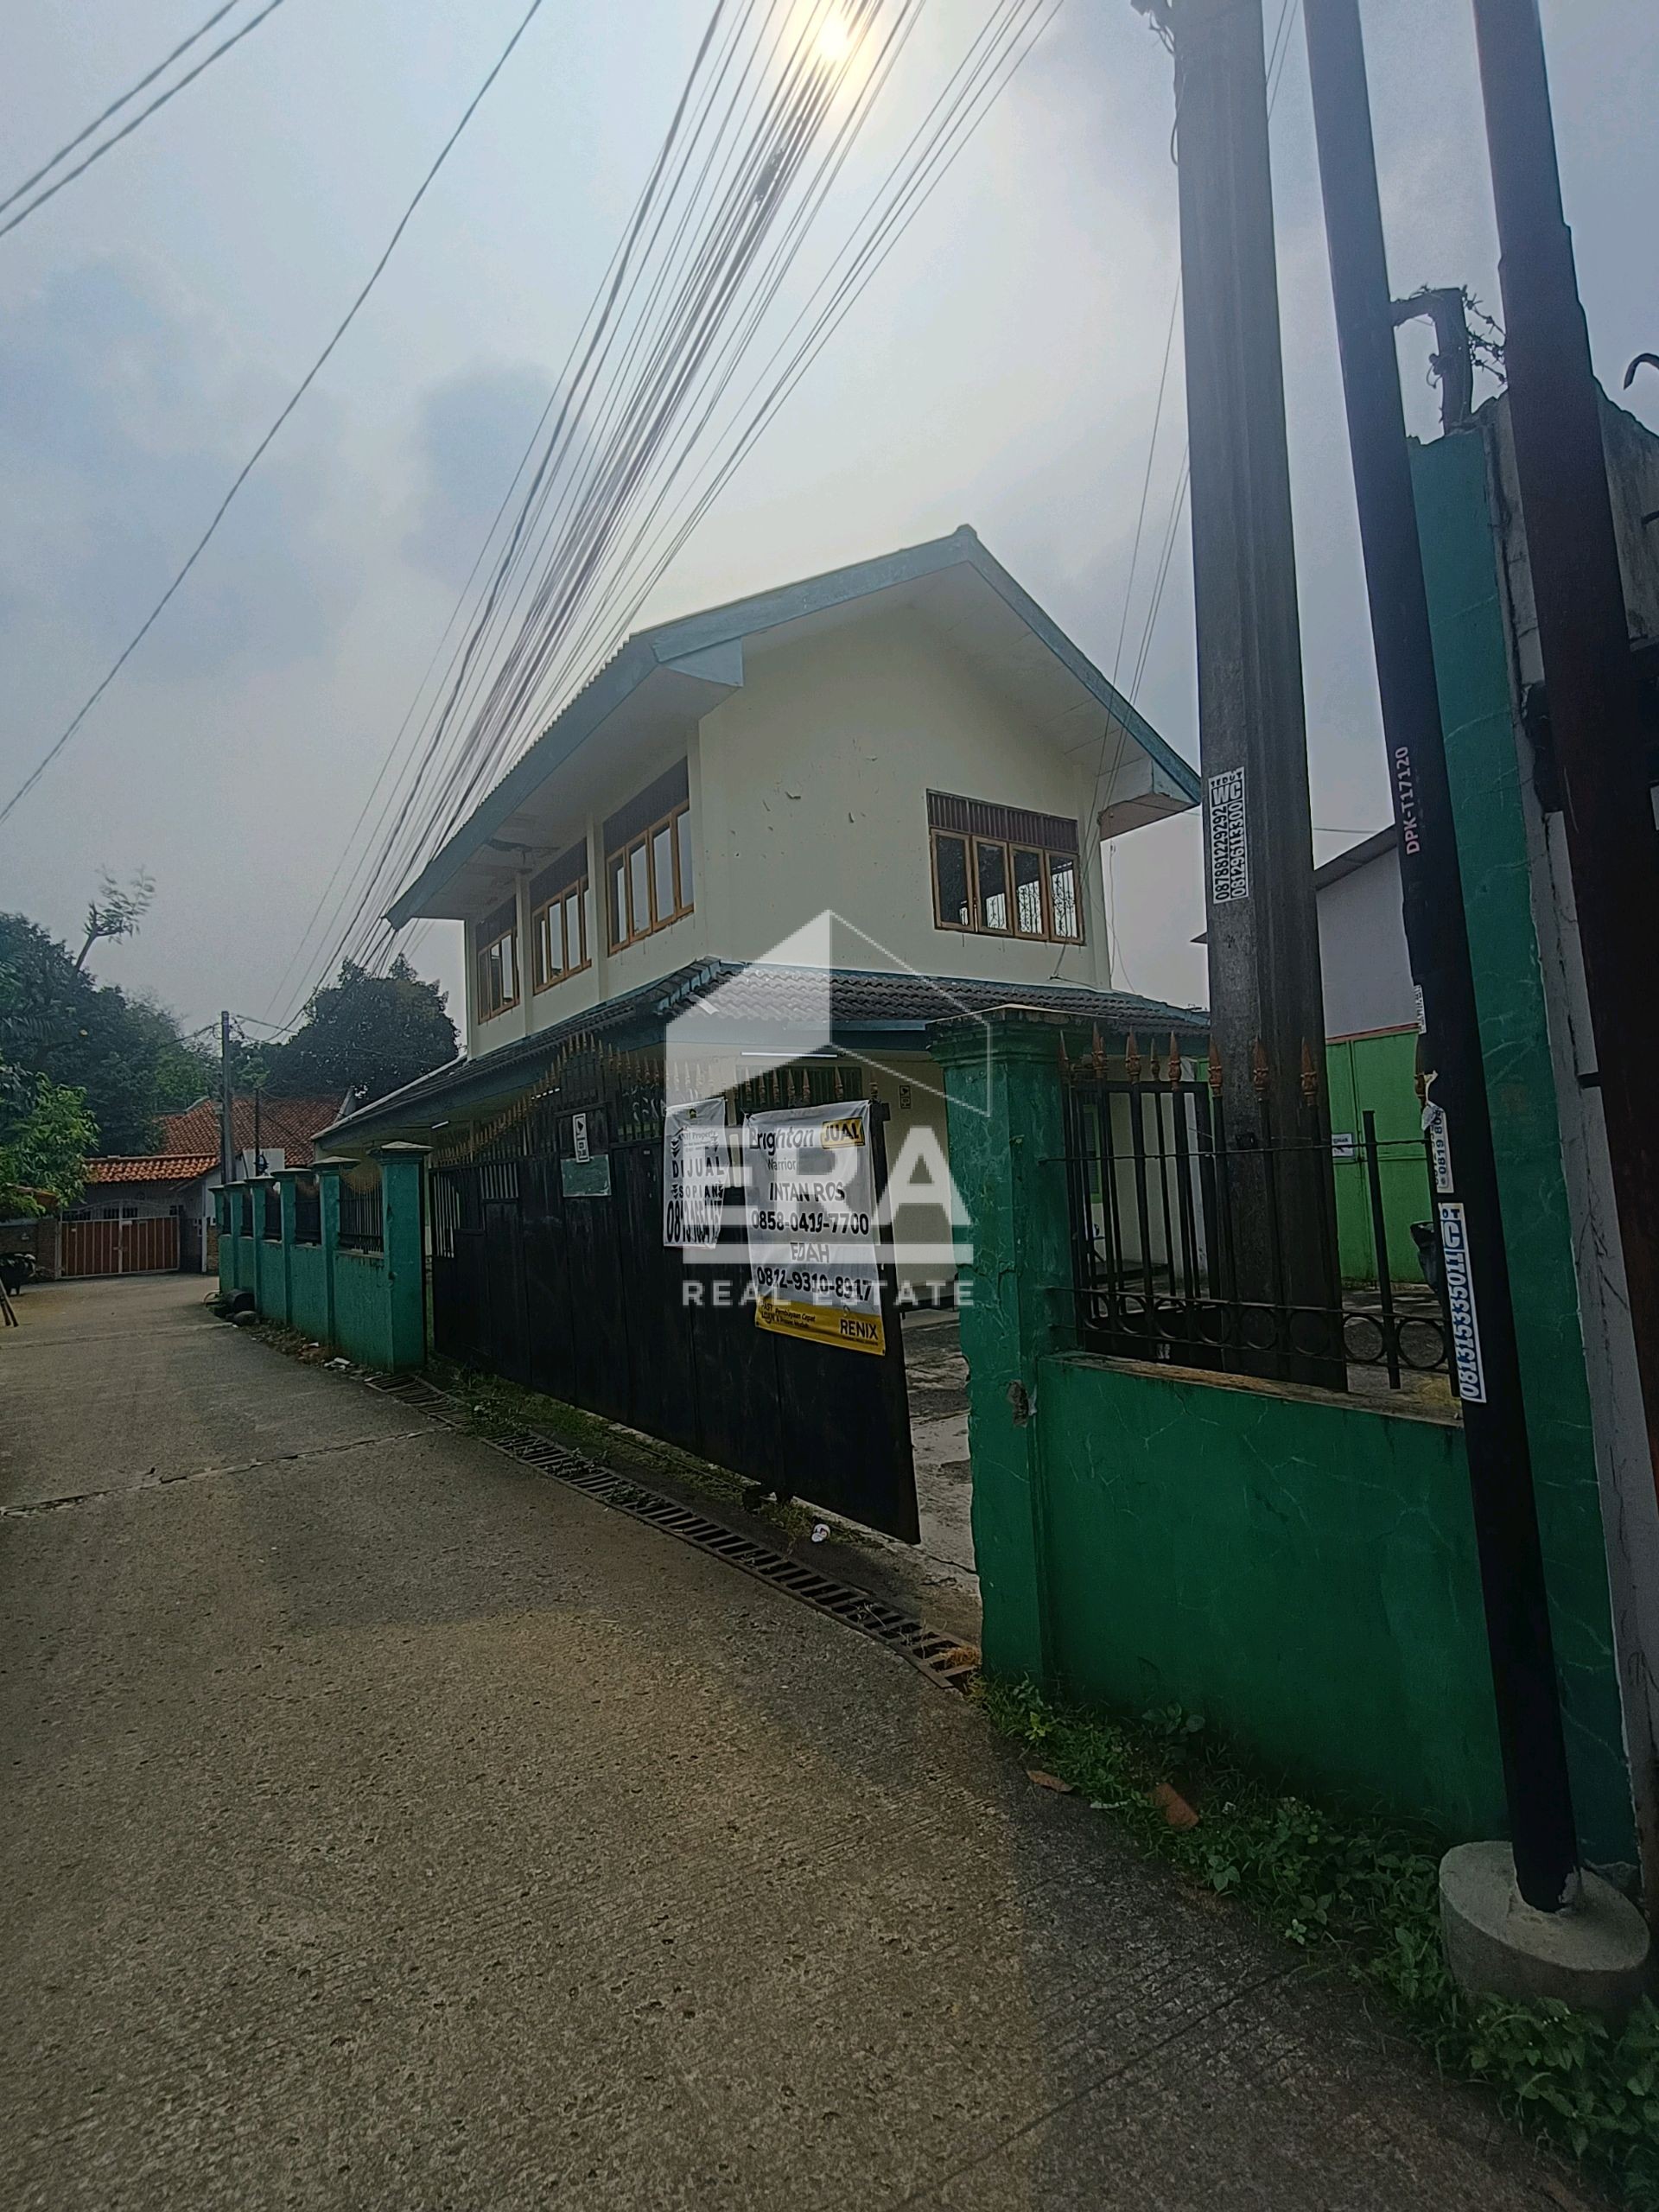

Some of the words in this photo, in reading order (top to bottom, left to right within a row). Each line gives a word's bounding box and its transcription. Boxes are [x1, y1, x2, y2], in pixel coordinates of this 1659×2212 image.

[1212, 781, 1242, 804] WC
[1395, 747, 1421, 855] DPK-T17120
[1212, 805, 1230, 900] 087881229292
[748, 1126, 814, 1155] Brighton
[824, 1122, 860, 1142] JUAL
[672, 1156, 725, 1179] DIJUAL
[766, 1158, 797, 1171] Warrior
[769, 1182, 810, 1202] INTAN
[816, 1181, 846, 1202] ROS
[751, 1211, 869, 1235] 0858-0419-7700
[840, 1319, 879, 1340] RENIX
[1445, 1253, 1479, 1398] 081315335011
